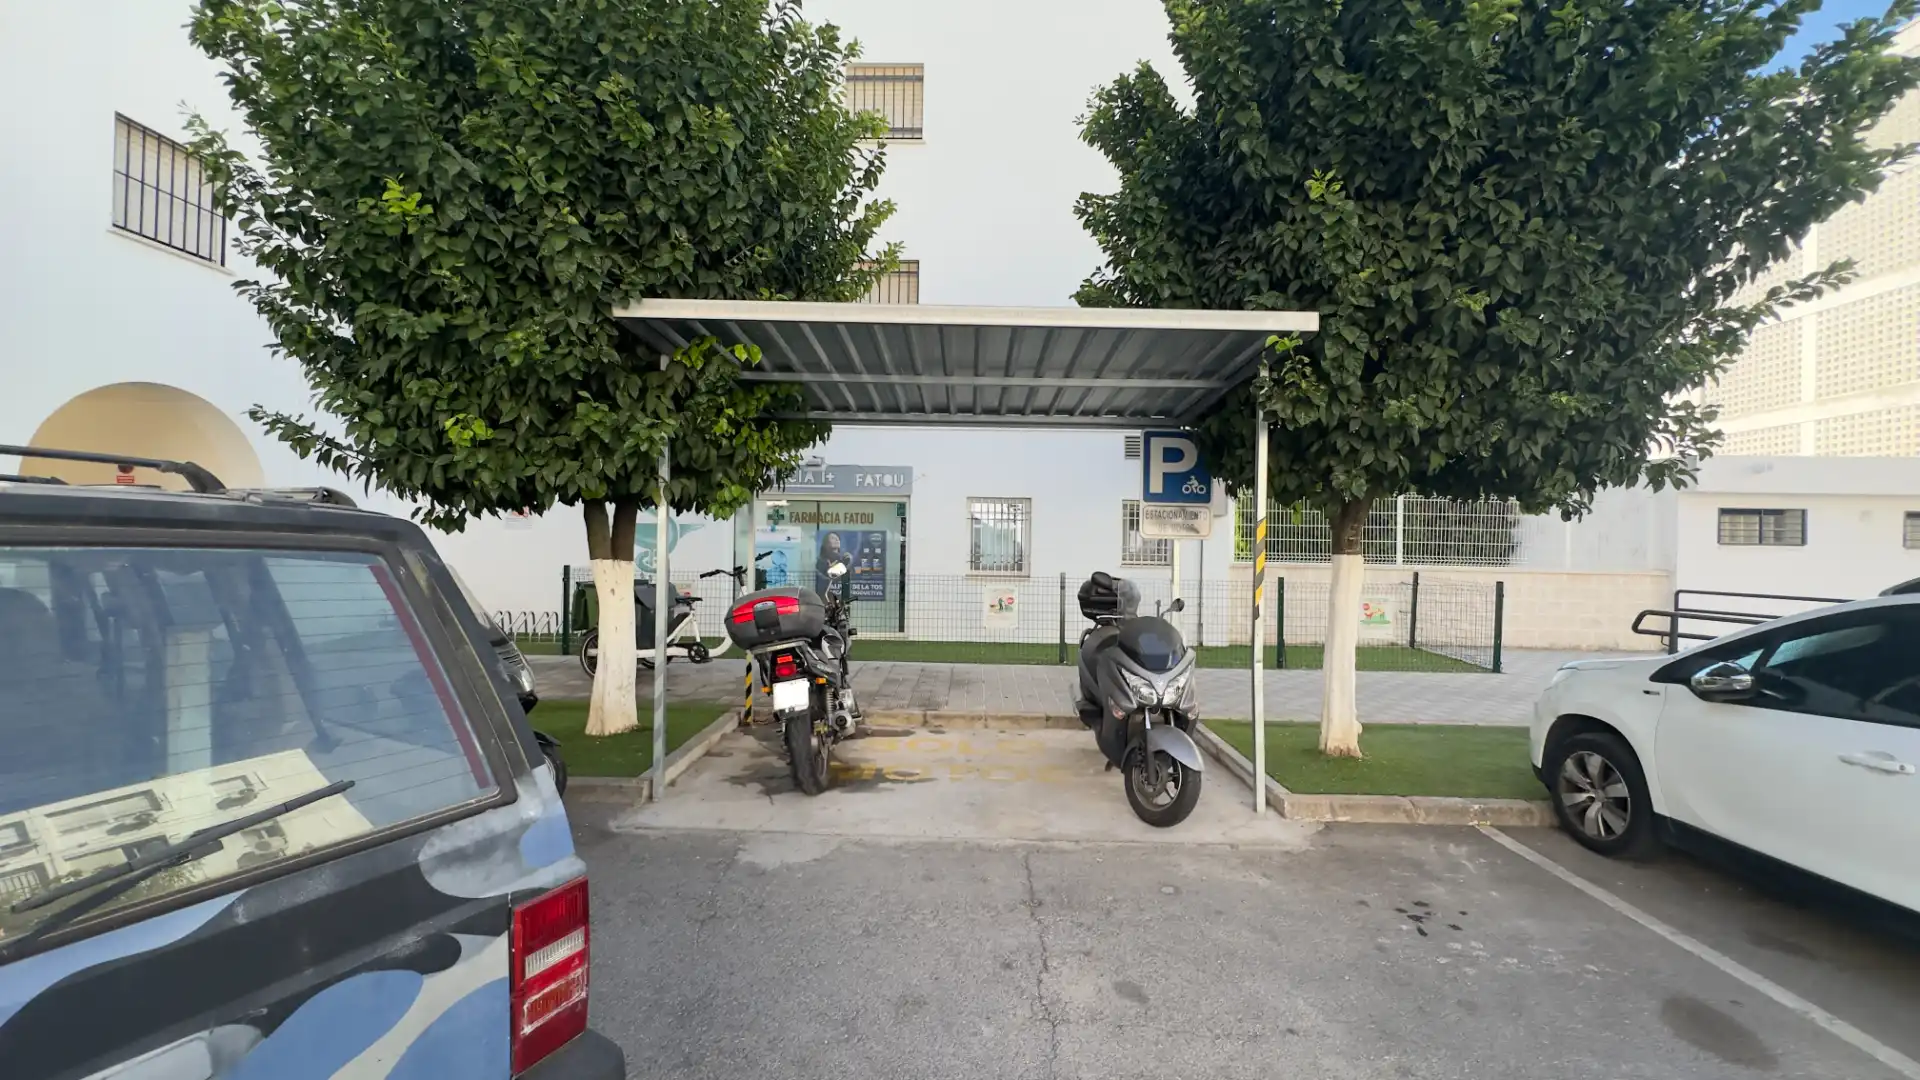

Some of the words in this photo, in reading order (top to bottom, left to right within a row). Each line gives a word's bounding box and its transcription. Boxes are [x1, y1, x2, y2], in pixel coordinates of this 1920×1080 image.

[1149, 437, 1198, 493] P
[856, 473, 904, 487] FATOU
[789, 511, 841, 524] FARMACIA
[844, 512, 874, 524] FATOU
